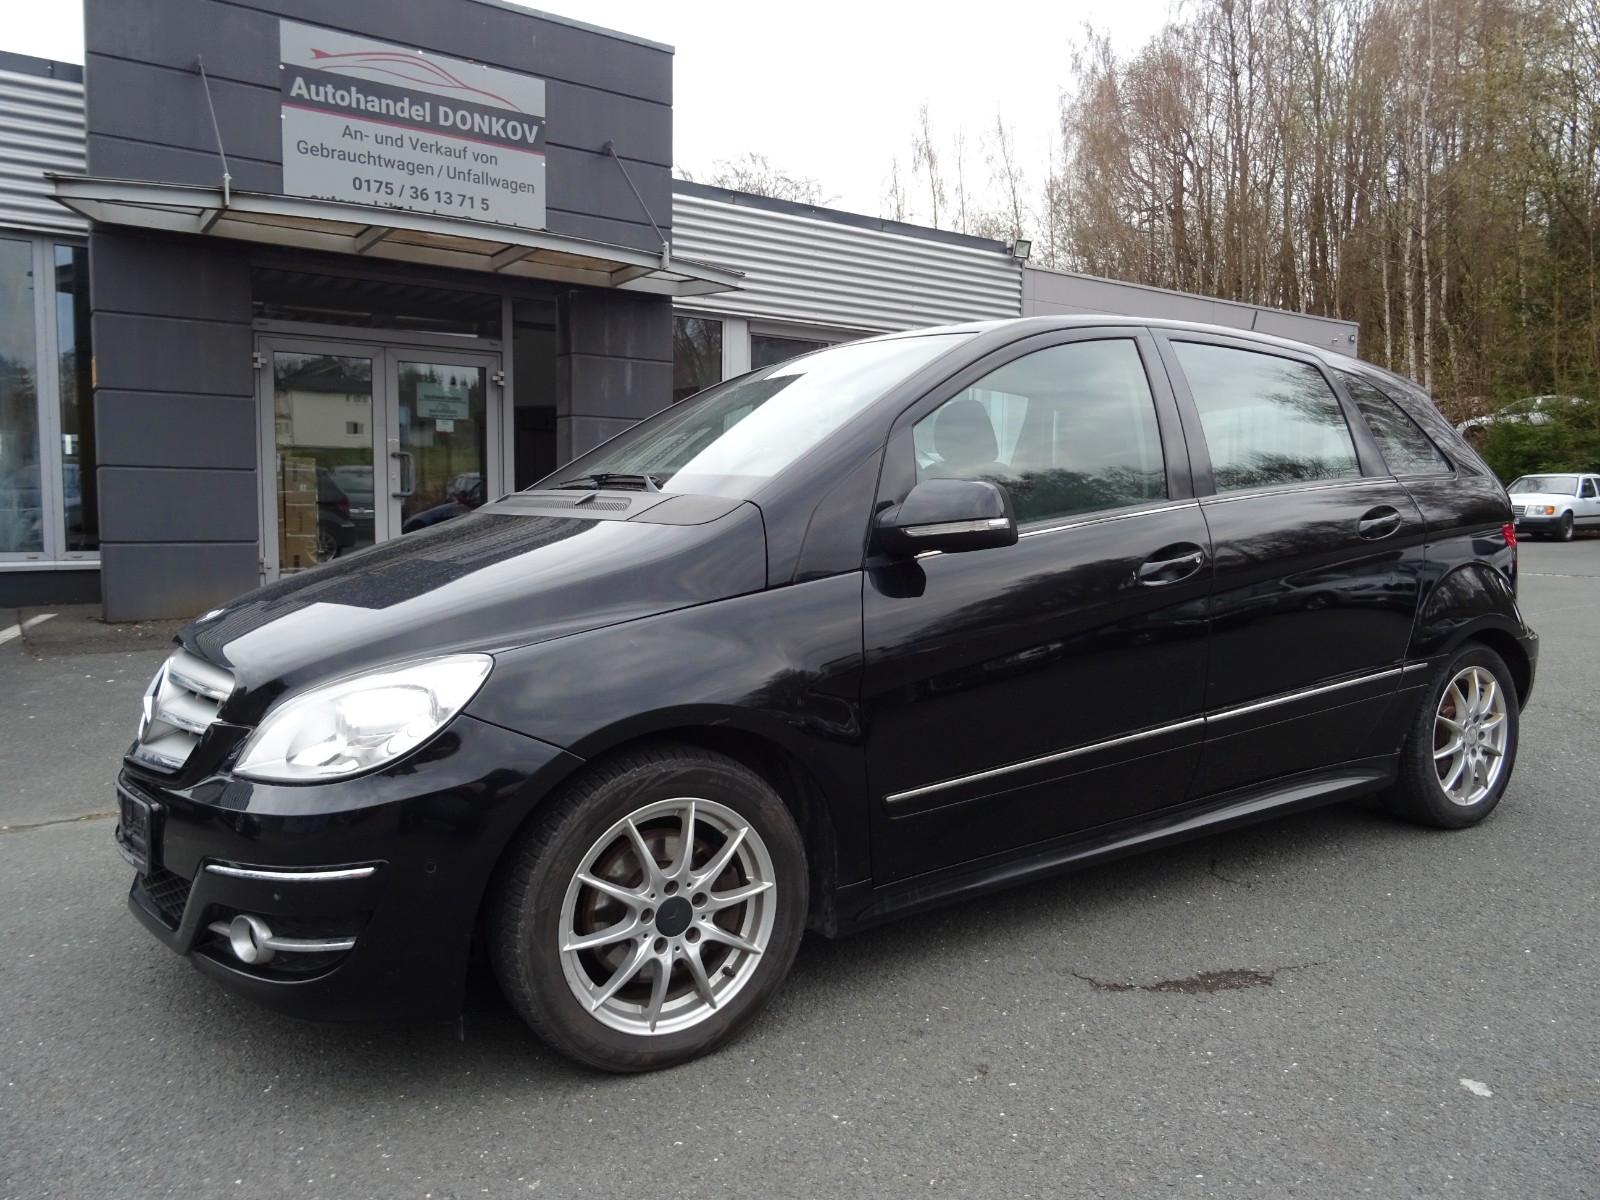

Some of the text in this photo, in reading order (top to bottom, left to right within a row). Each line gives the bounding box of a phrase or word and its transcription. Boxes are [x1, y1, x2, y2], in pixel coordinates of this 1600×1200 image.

[290, 76, 539, 144] Autohandel DONKOV
[341, 125, 498, 166] An- und Verkauf von
[352, 177, 394, 195] 0175
